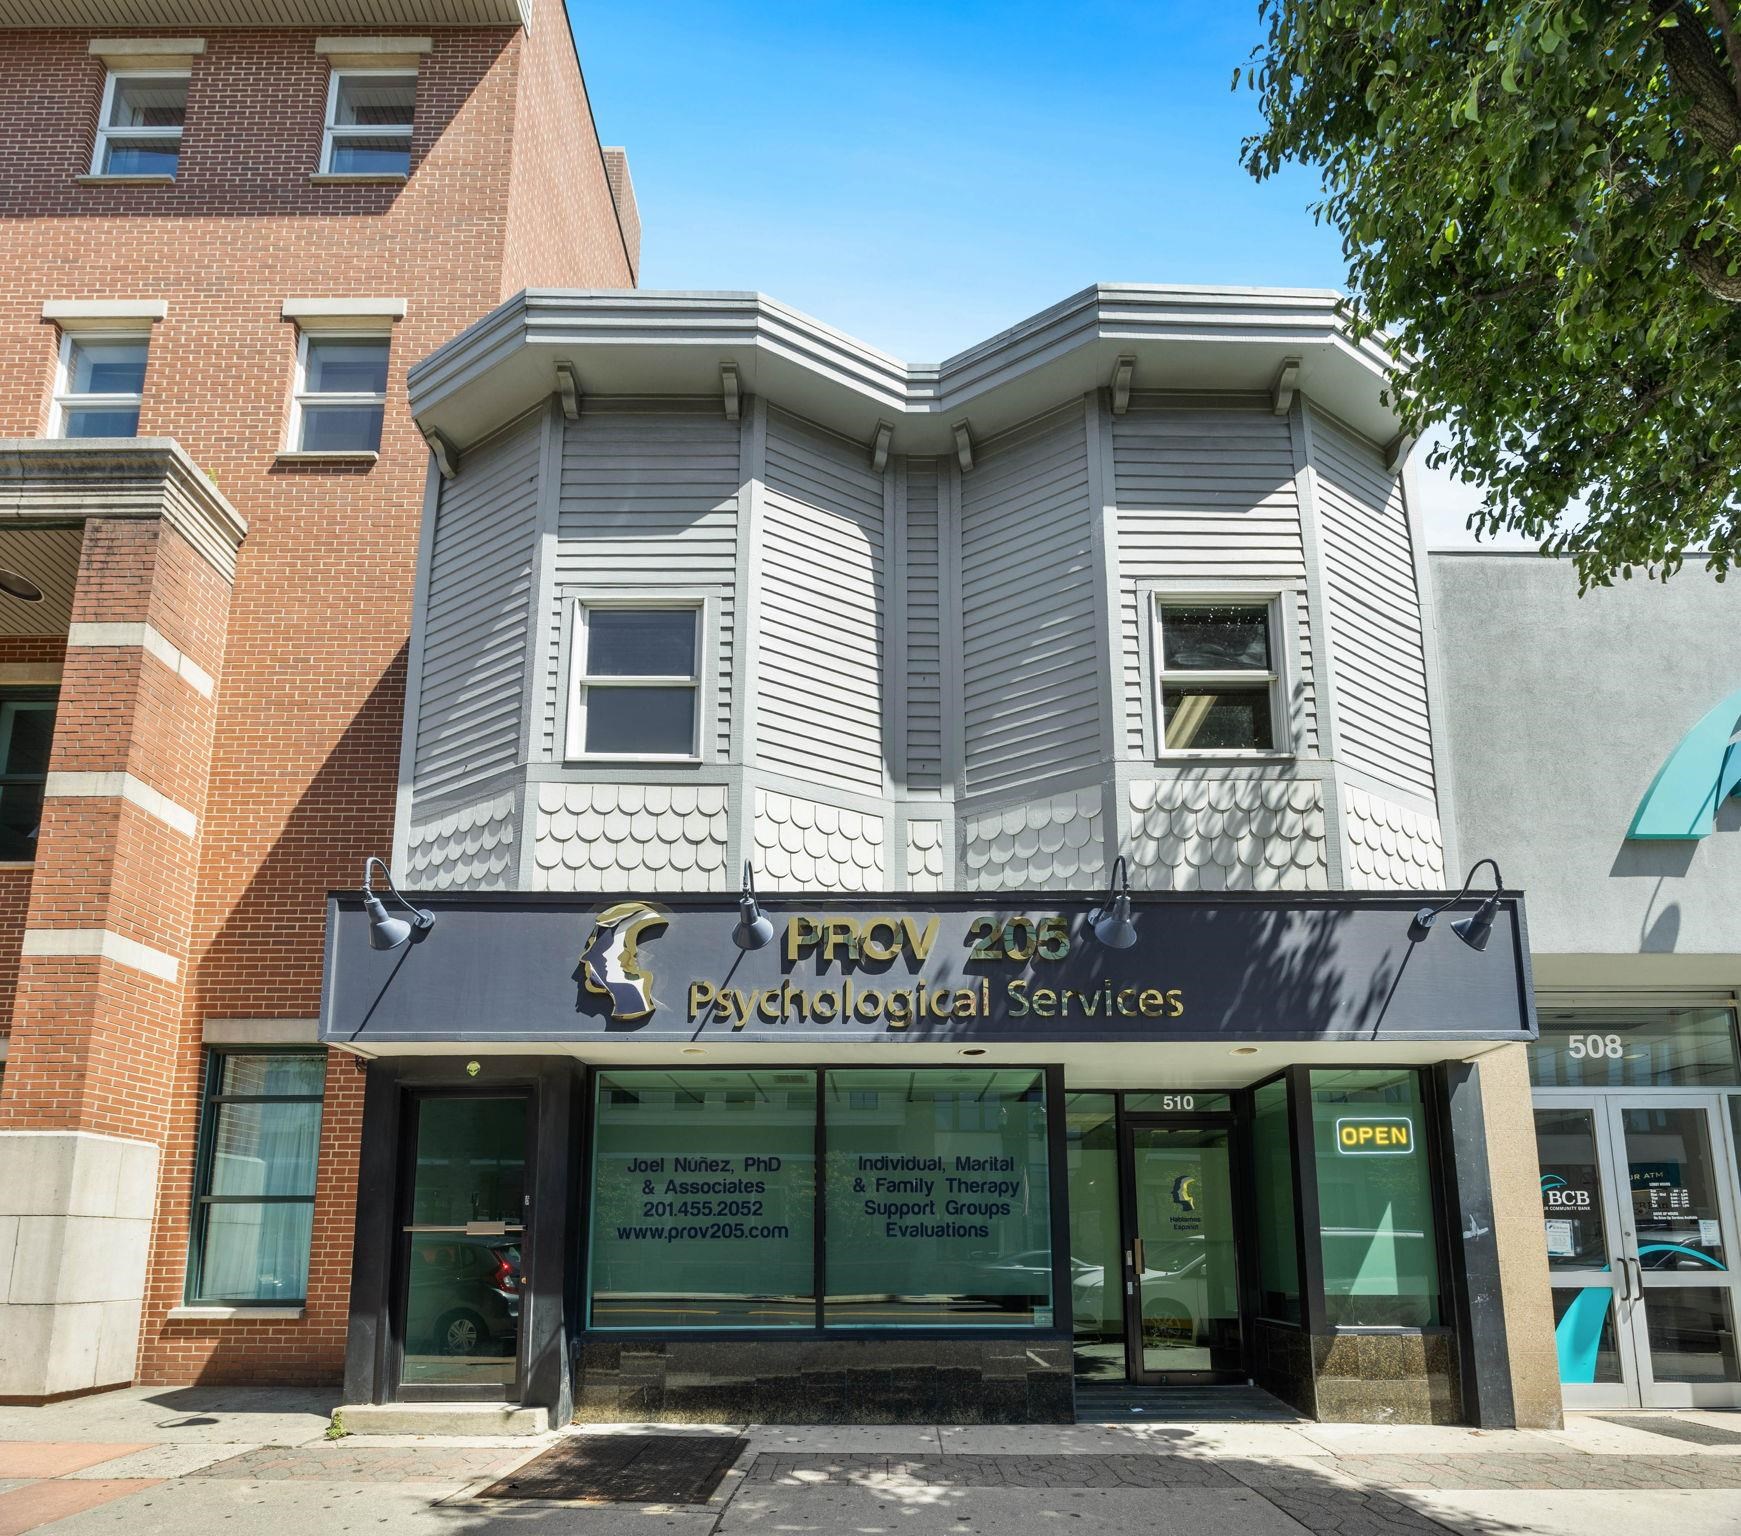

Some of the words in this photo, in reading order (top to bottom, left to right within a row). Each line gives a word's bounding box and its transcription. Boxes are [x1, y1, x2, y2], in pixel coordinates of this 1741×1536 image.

[787, 916, 941, 960] PROV
[970, 916, 1070, 960] 205
[689, 976, 990, 1027] Psychological
[1007, 979, 1184, 1017] Services
[1569, 1034, 1624, 1059] 508
[1162, 1095, 1194, 1110] 510
[1341, 1126, 1407, 1145] OPEN
[627, 1157, 665, 1173] Joel
[674, 1156, 735, 1176] Núñez,
[744, 1156, 782, 1172] PhD
[858, 1155, 946, 1174] Individual,
[955, 1156, 1015, 1172] Marital
[642, 1179, 655, 1195] &
[664, 1178, 766, 1195] Associates
[853, 1178, 866, 1193] &
[875, 1177, 935, 1198] Family
[945, 1177, 1020, 1198] Therapy
[1547, 1190, 1590, 1205] BCB
[643, 1200, 764, 1217] 201.455.2052
[864, 1199, 936, 1218] Support
[945, 1199, 1011, 1218] Groups
[616, 1222, 790, 1244] www.prov205.com
[886, 1221, 990, 1239] Evaluations
